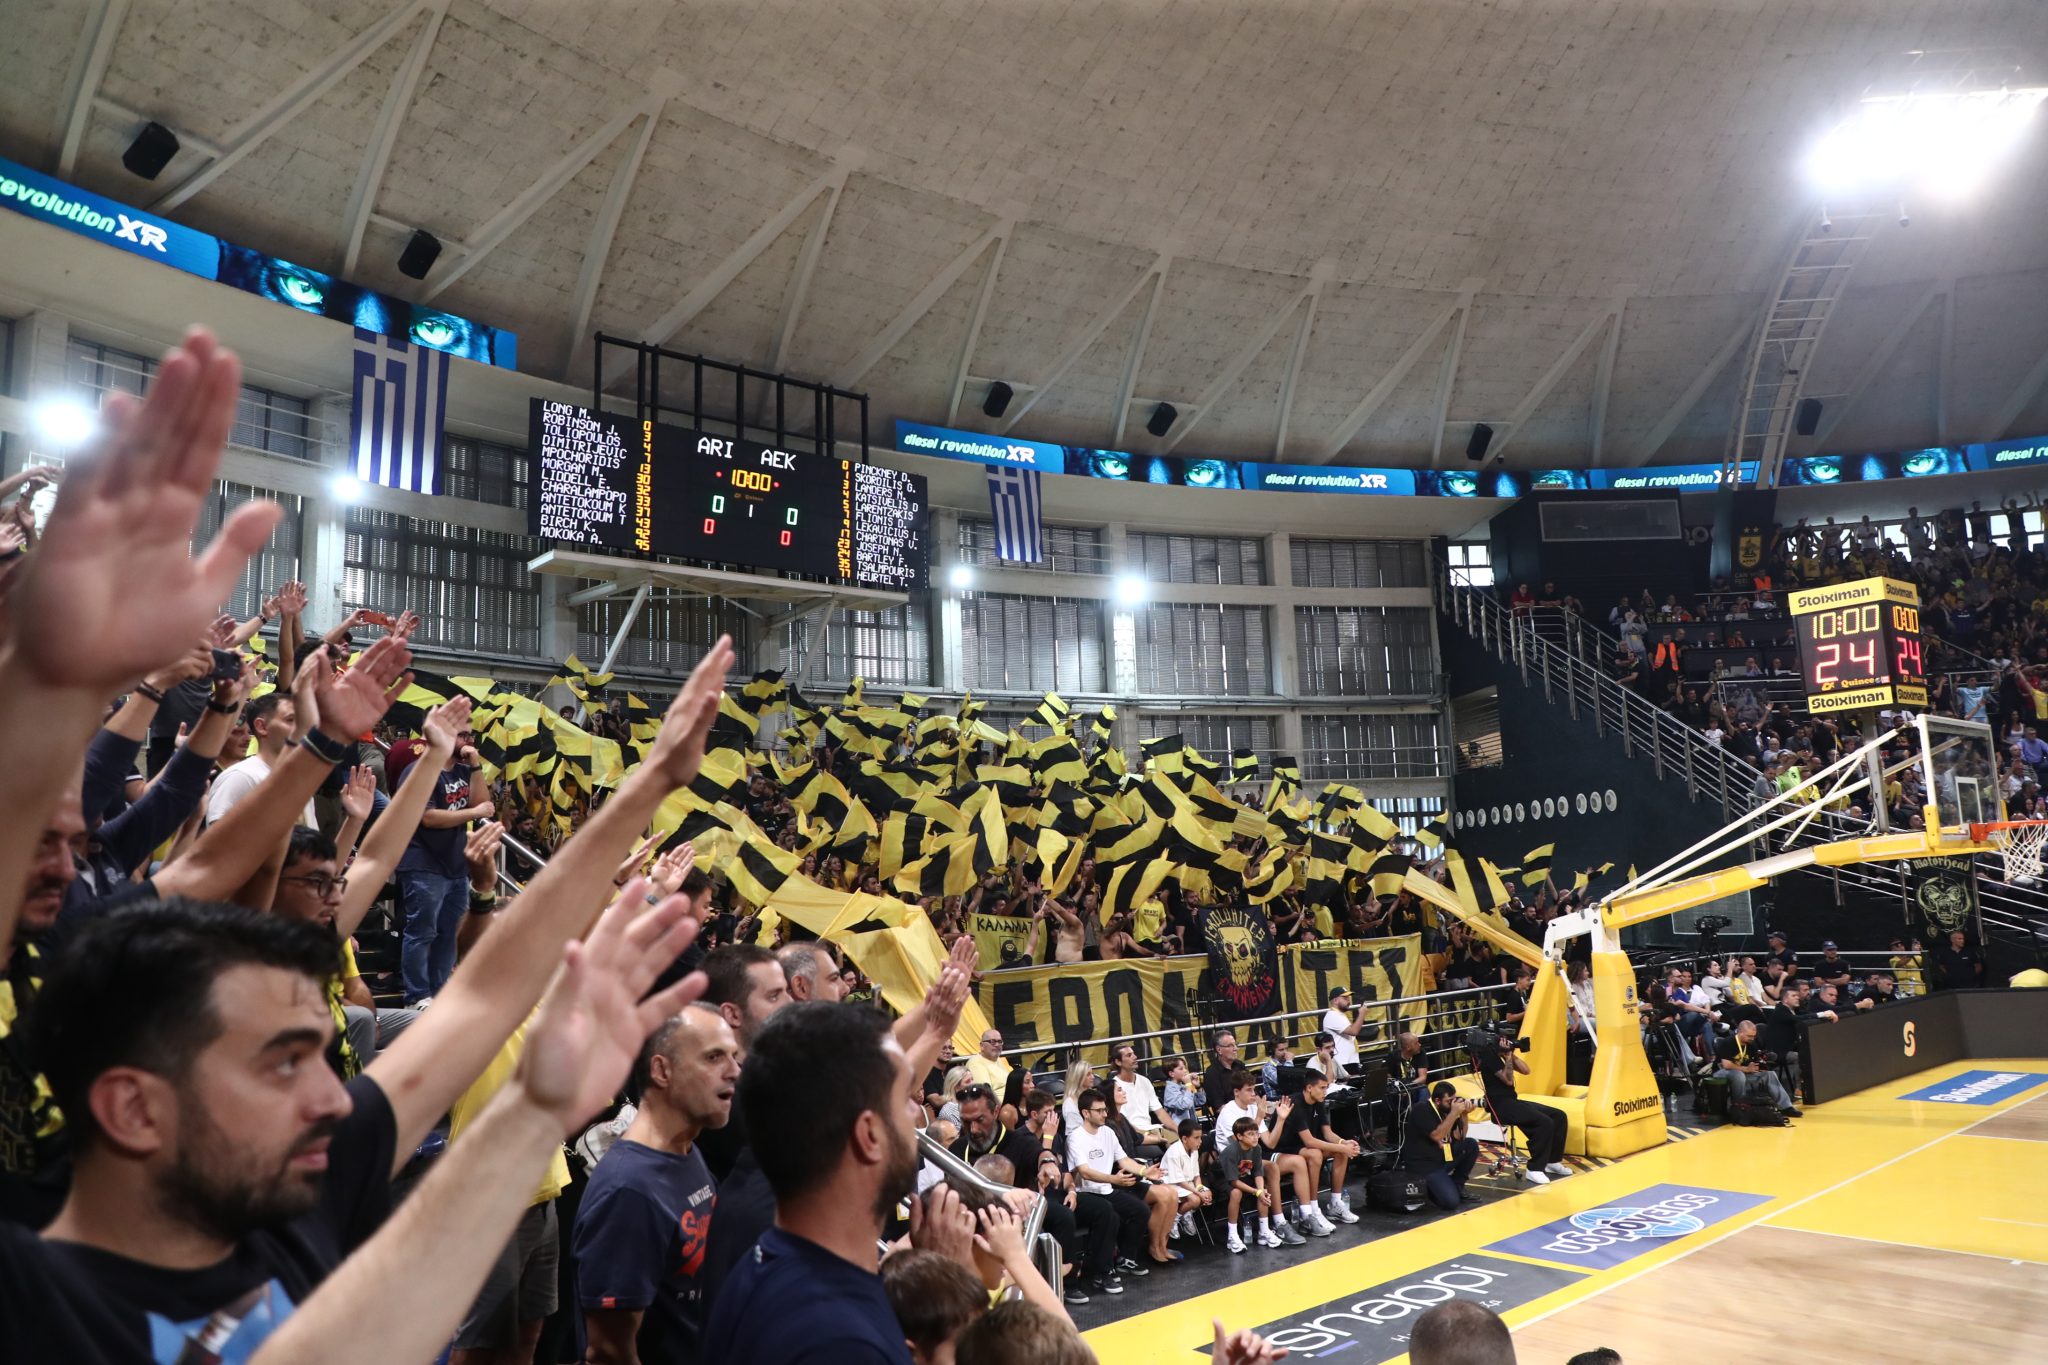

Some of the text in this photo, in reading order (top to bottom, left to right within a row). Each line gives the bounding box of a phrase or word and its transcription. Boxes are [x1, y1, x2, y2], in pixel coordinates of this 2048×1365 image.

[115, 213, 167, 252] XR
[542, 412, 652, 442] ROBINSON J. 3
[543, 400, 652, 431] LONG M. 0
[542, 434, 651, 462] DIMITRIJEVIC 7
[544, 423, 652, 452] TOLIOPOULOS 4
[904, 434, 1036, 464] diesel revolution XR
[542, 446, 651, 474] MPOCHORIDIS 13
[697, 436, 797, 471] ARI AEK
[1996, 448, 2034, 462] diesel
[542, 458, 651, 485] MORGAN M. 30
[542, 469, 651, 496] LIDDELL E. 32
[731, 468, 772, 492] 10:00
[842, 460, 911, 482] 0 PINCKNEY D.
[845, 470, 916, 494] 1 SKORDILIS G.
[1265, 474, 1388, 488] diesel revolution XR
[1614, 477, 1646, 488] diesel
[1648, 474, 1714, 486] revolution
[541, 480, 651, 507] CHARALAMPOPO 33
[842, 480, 906, 500] 3 LANDERS N.
[842, 490, 918, 512] 4 KATSIVELIS D
[540, 492, 651, 517] ANTETOKOUM K 37
[540, 503, 651, 528] ANTETOKOUM T 43
[712, 494, 725, 514] 0
[786, 507, 799, 526] 0
[842, 500, 914, 520] 5 LARENTZAKIS
[540, 514, 651, 540] BIRCH K. 92
[843, 518, 918, 540] 9 LEKAVICIUS L
[844, 509, 906, 529] 7 FLIONIS D.
[540, 526, 650, 550] MOKOKA A. 95
[704, 518, 792, 546] 0 0
[856, 531, 904, 548] CHARTONAS
[838, 538, 902, 557] 23 JOSEPH N.
[838, 548, 908, 568] 24 BARTLEY F.
[838, 558, 915, 578] 35 TSALMPOURIS
[838, 568, 908, 588] 77 HEURTEL T.
[1798, 586, 1870, 608] Stoiximan
[1812, 604, 1880, 640] 10:00
[1892, 605, 1920, 634] 10:00
[1816, 638, 1875, 684] 24
[1896, 636, 1922, 676] 24
[1811, 692, 1885, 709] Stoiximan
[1614, 1094, 1659, 1116] Stoiximan
[687, 1184, 714, 1208] VINTAGE
[1262, 1264, 1509, 1351] snappi
